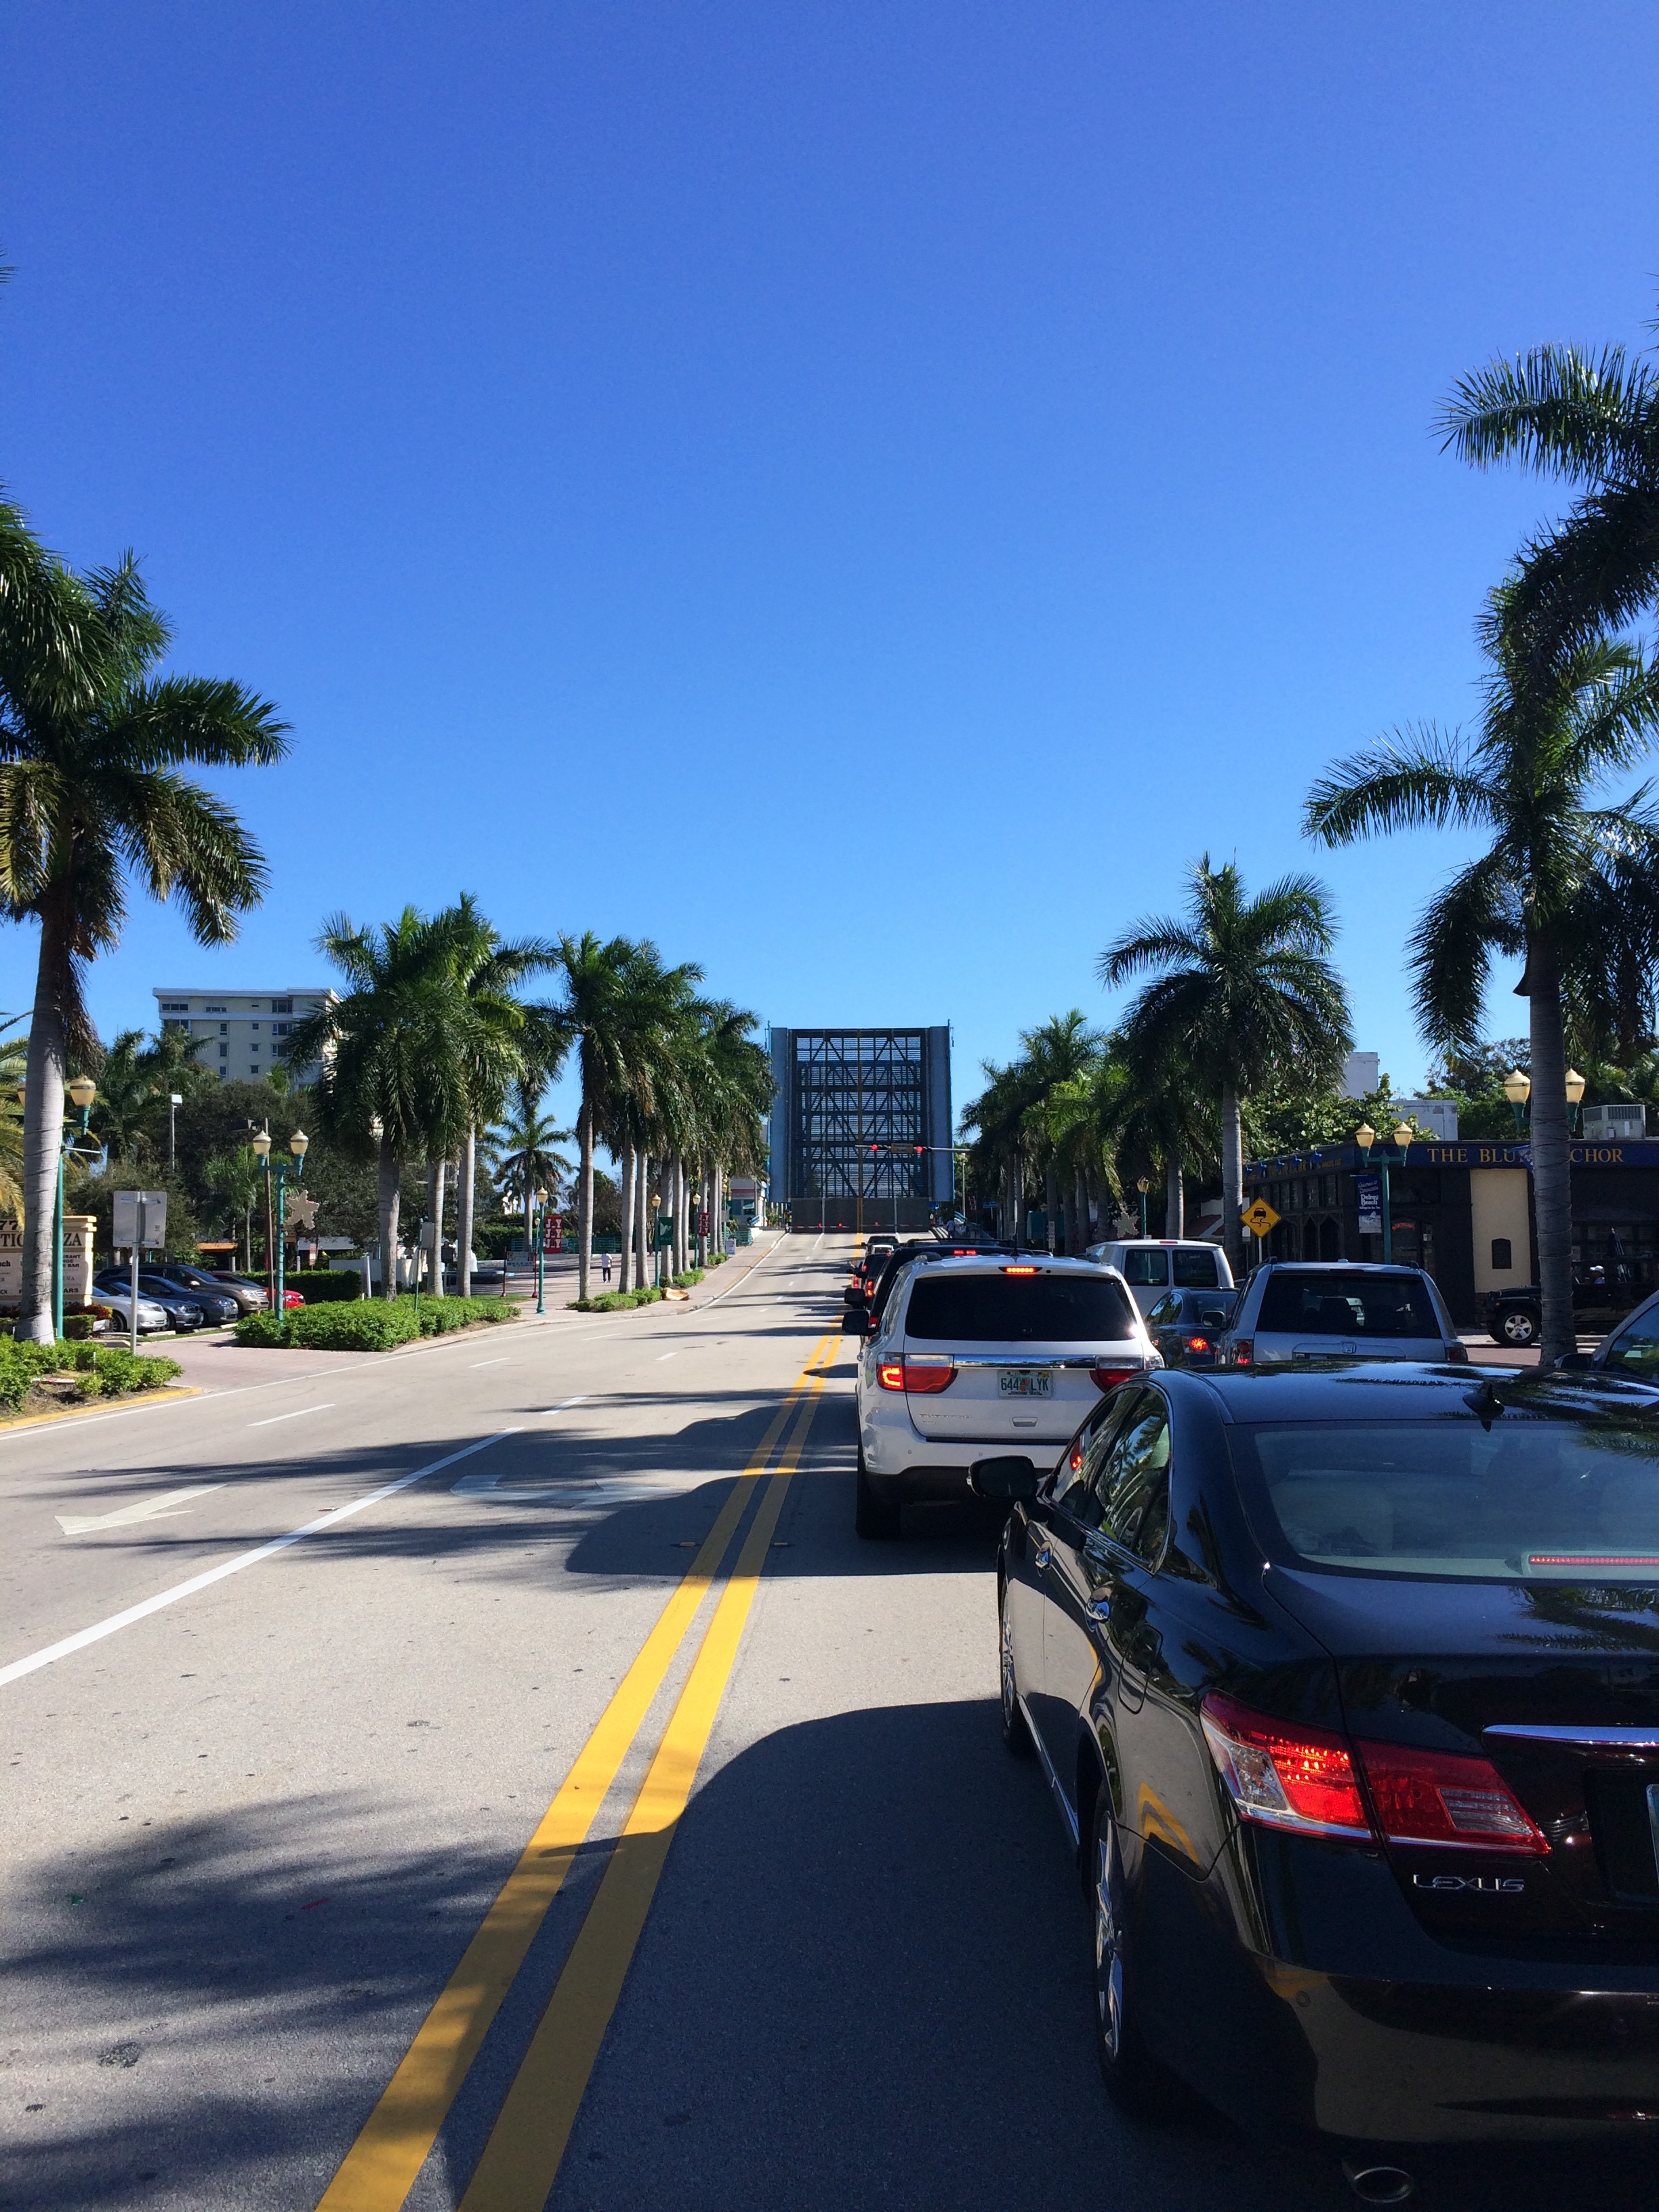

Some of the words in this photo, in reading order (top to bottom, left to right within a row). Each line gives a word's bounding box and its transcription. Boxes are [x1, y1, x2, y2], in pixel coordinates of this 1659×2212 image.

[1427, 1148, 1469, 1163] THE
[1479, 1148, 1524, 1163] BLU
[1570, 1148, 1624, 1163] CHOR
[546, 1219, 562, 1228] JY
[63, 1233, 82, 1246] ZA
[546, 1229, 562, 1238] JY
[546, 1239, 561, 1248] JY
[1000, 1378, 1019, 1391] 644
[1031, 1378, 1049, 1391] LYK
[1413, 1874, 1524, 1892] LEXUS
